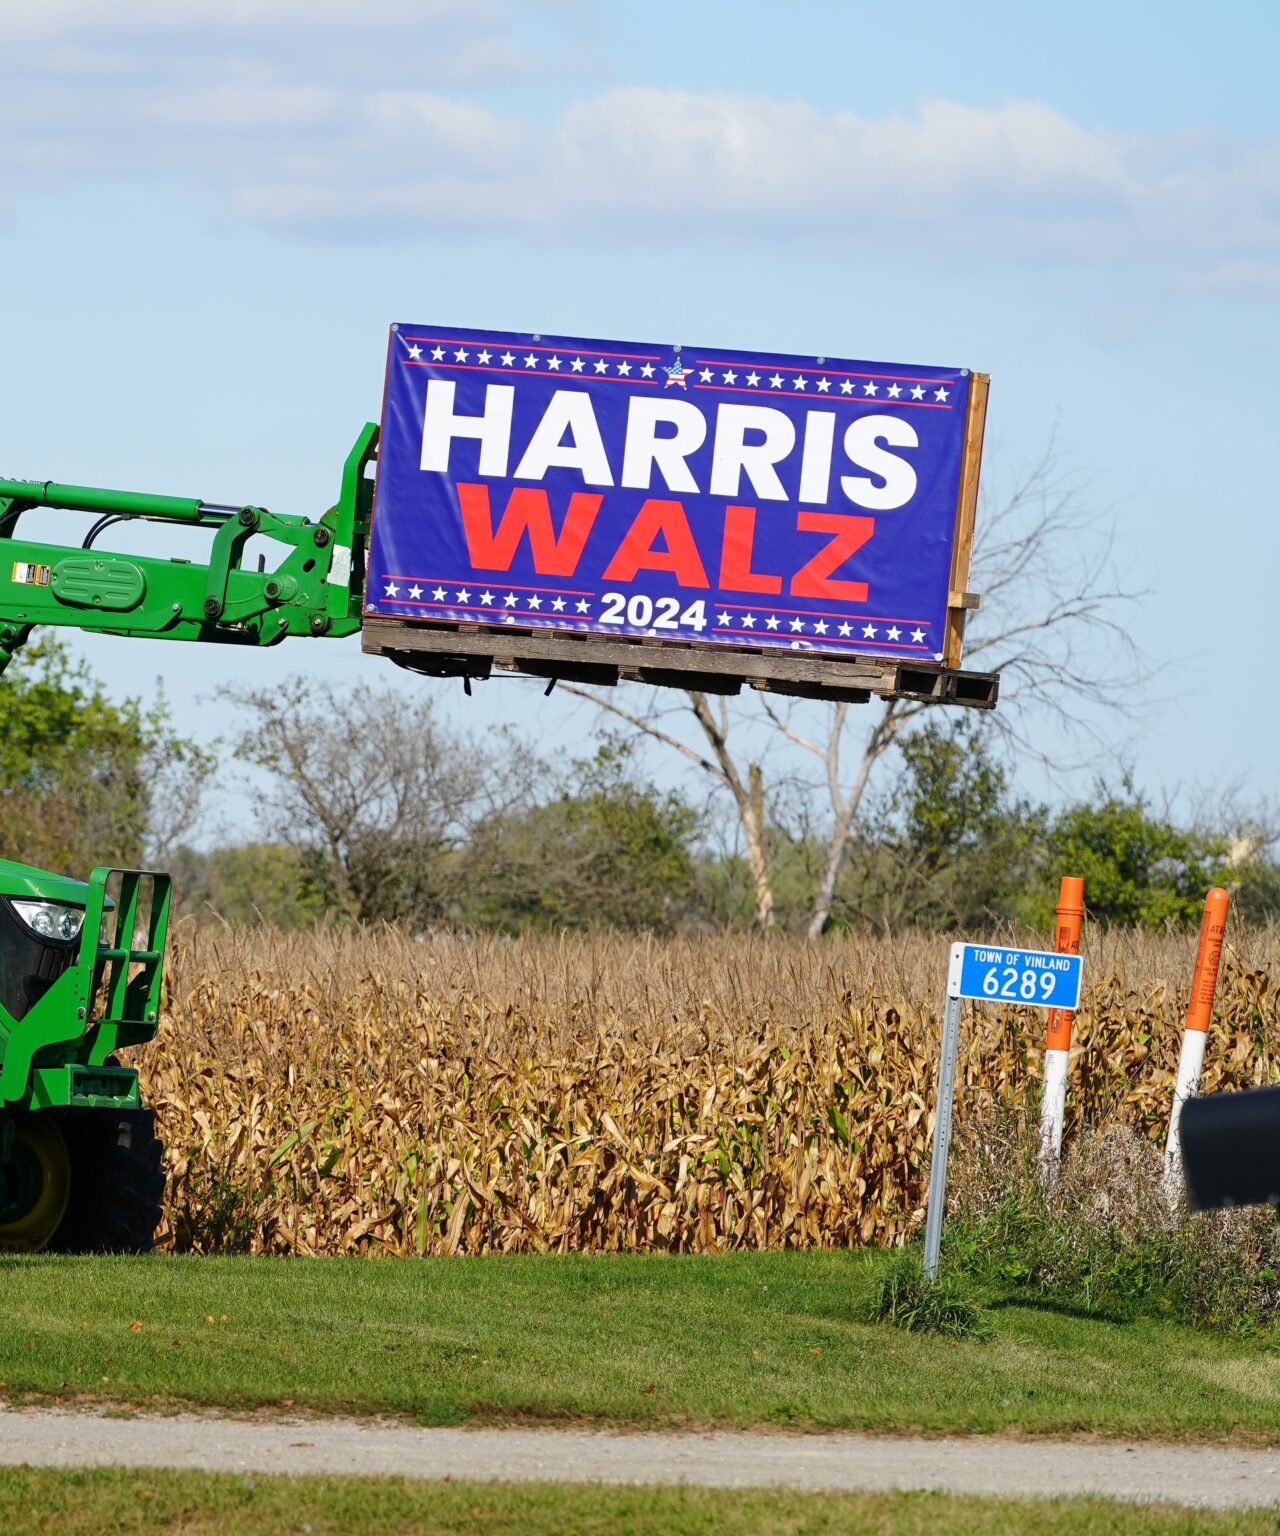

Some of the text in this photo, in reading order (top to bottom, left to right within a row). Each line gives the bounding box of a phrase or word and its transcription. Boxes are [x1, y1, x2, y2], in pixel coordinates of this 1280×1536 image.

[420, 379, 919, 510] HARRIS
[456, 482, 875, 603] WALZ
[598, 592, 708, 632] 2024
[974, 949, 1071, 972] TOWN OF VINLAND
[982, 966, 1056, 1000] 6289
